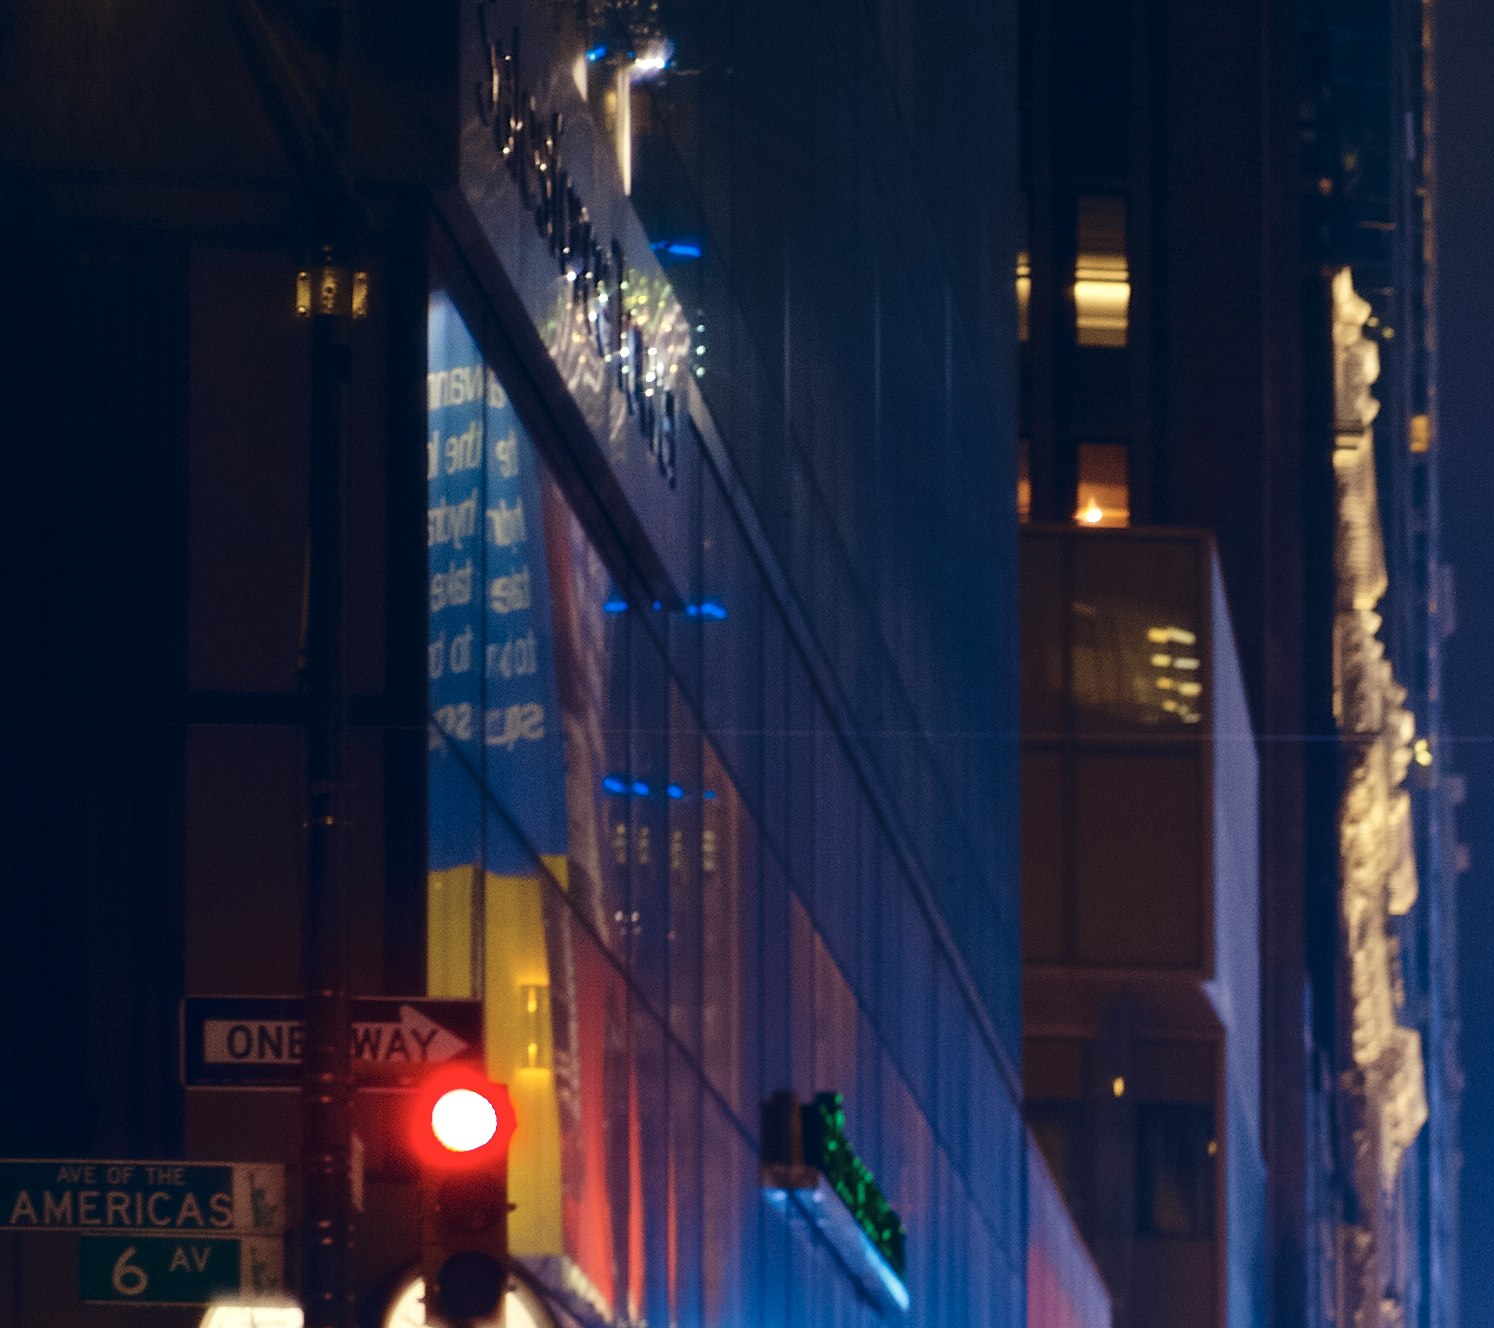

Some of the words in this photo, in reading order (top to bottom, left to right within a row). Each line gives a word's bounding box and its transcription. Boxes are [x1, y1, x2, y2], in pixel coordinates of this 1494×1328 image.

[226, 1022, 304, 1060] ONE
[350, 1027, 438, 1063] WAY
[57, 1166, 97, 1185] AVE
[106, 1167, 134, 1185] OF
[145, 1167, 186, 1186] THE
[9, 1190, 234, 1228] AMERICAS
[112, 1246, 149, 1296] 6
[169, 1247, 211, 1273] AV
